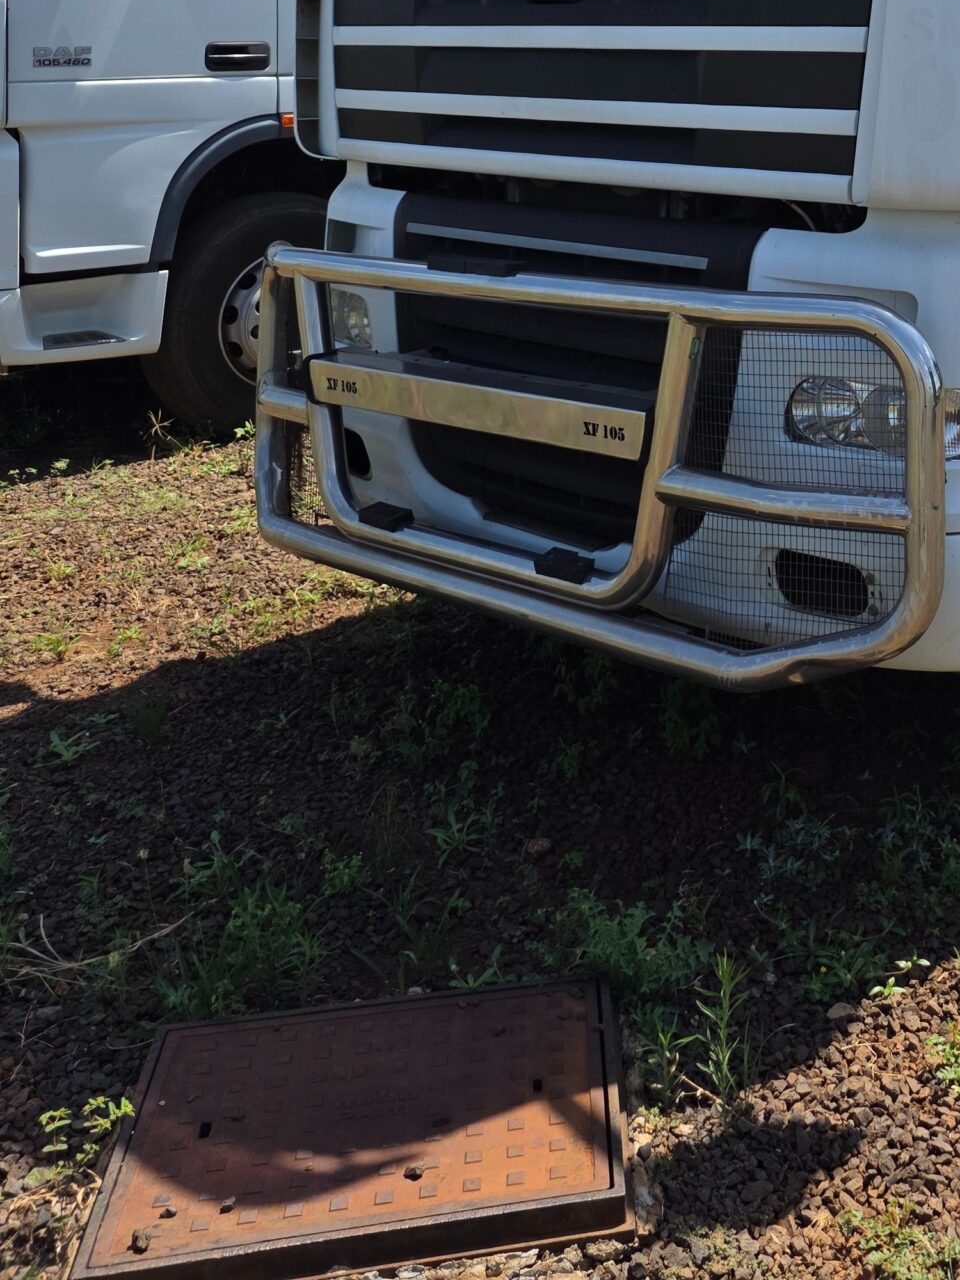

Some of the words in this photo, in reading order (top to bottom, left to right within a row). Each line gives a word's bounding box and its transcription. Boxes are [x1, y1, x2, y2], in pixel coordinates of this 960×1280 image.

[33, 46, 92, 57] DAF
[327, 377, 338, 391] XF
[341, 380, 357, 394] 105
[583, 421, 599, 437] XF
[603, 424, 625, 442] 105
